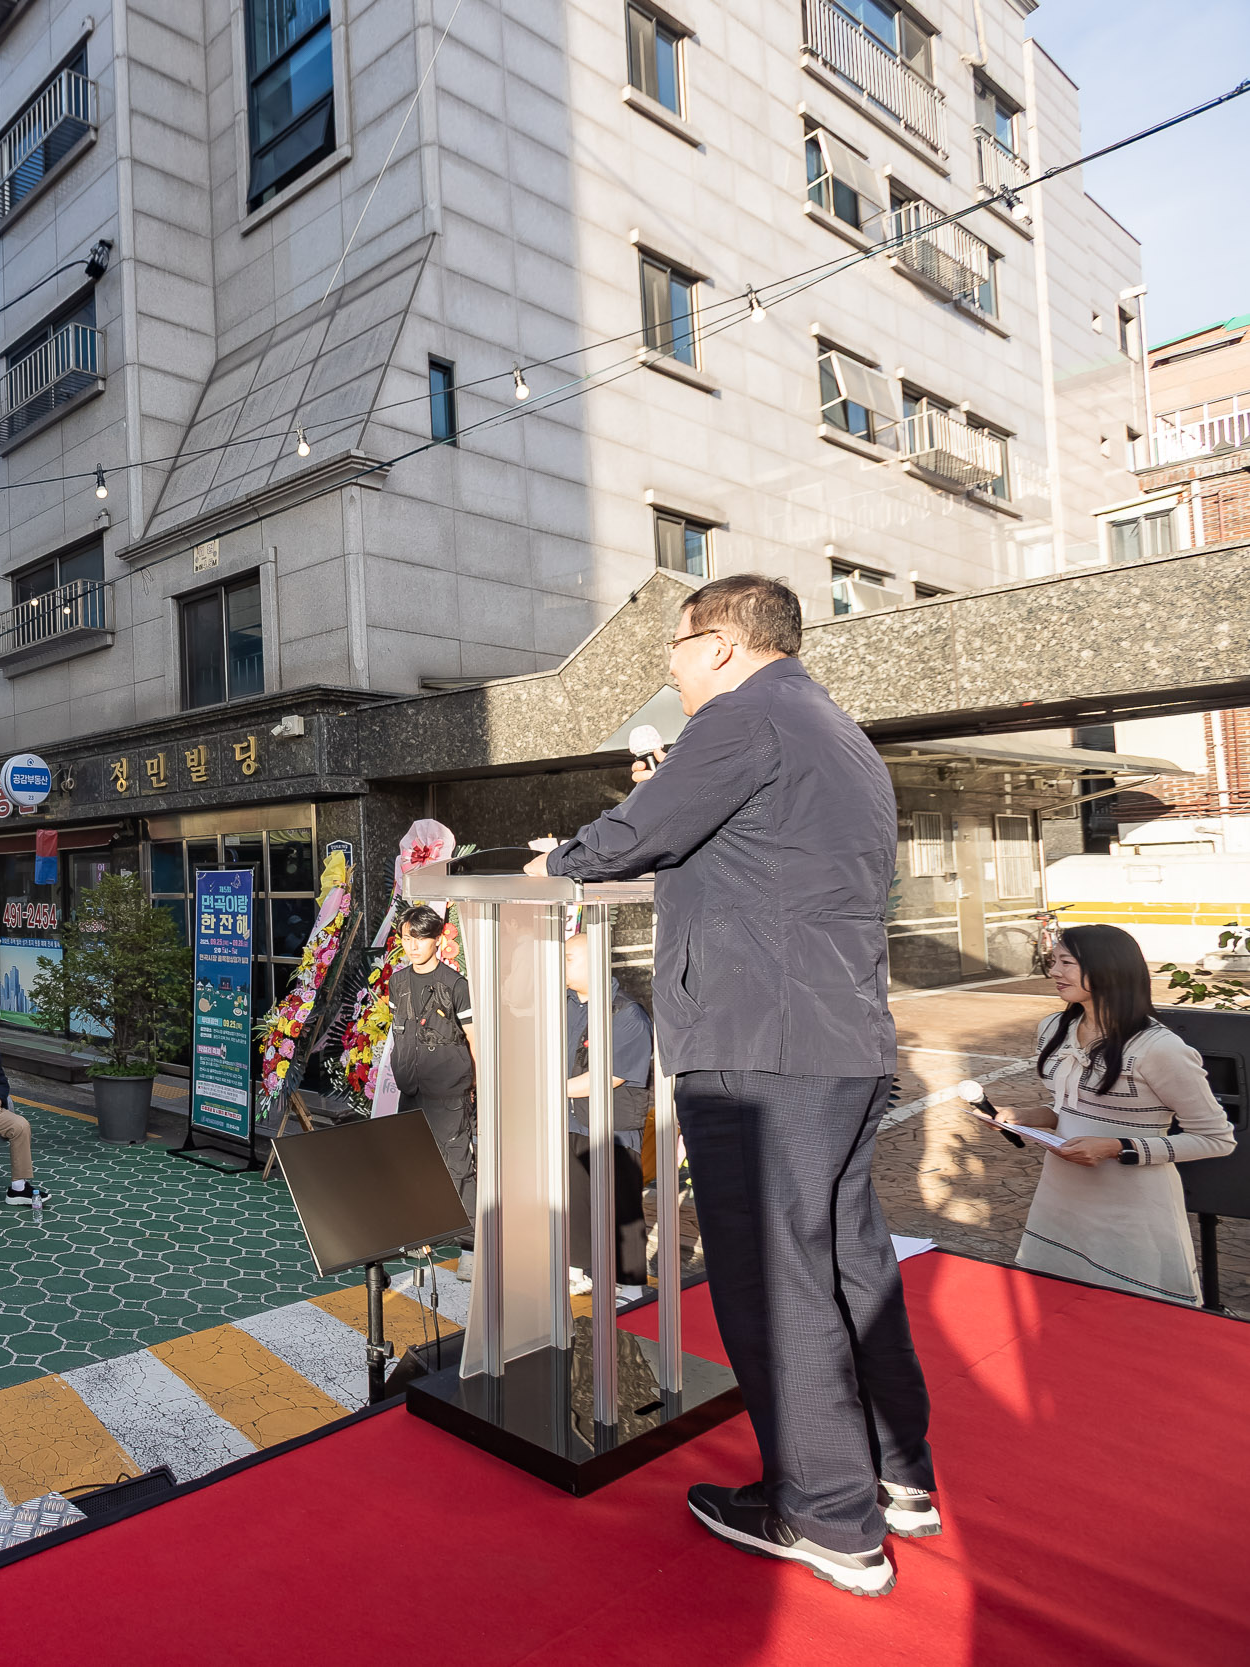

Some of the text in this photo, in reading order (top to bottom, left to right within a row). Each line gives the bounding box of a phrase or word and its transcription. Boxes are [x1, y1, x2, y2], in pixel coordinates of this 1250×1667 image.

[110, 736, 258, 793] 정민빌딩
[13, 774, 49, 786] 공감부동산
[201, 895, 248, 913] 면곡이랑
[3, 902, 58, 930] 491-2454
[201, 913, 249, 935] 한 잔 해
